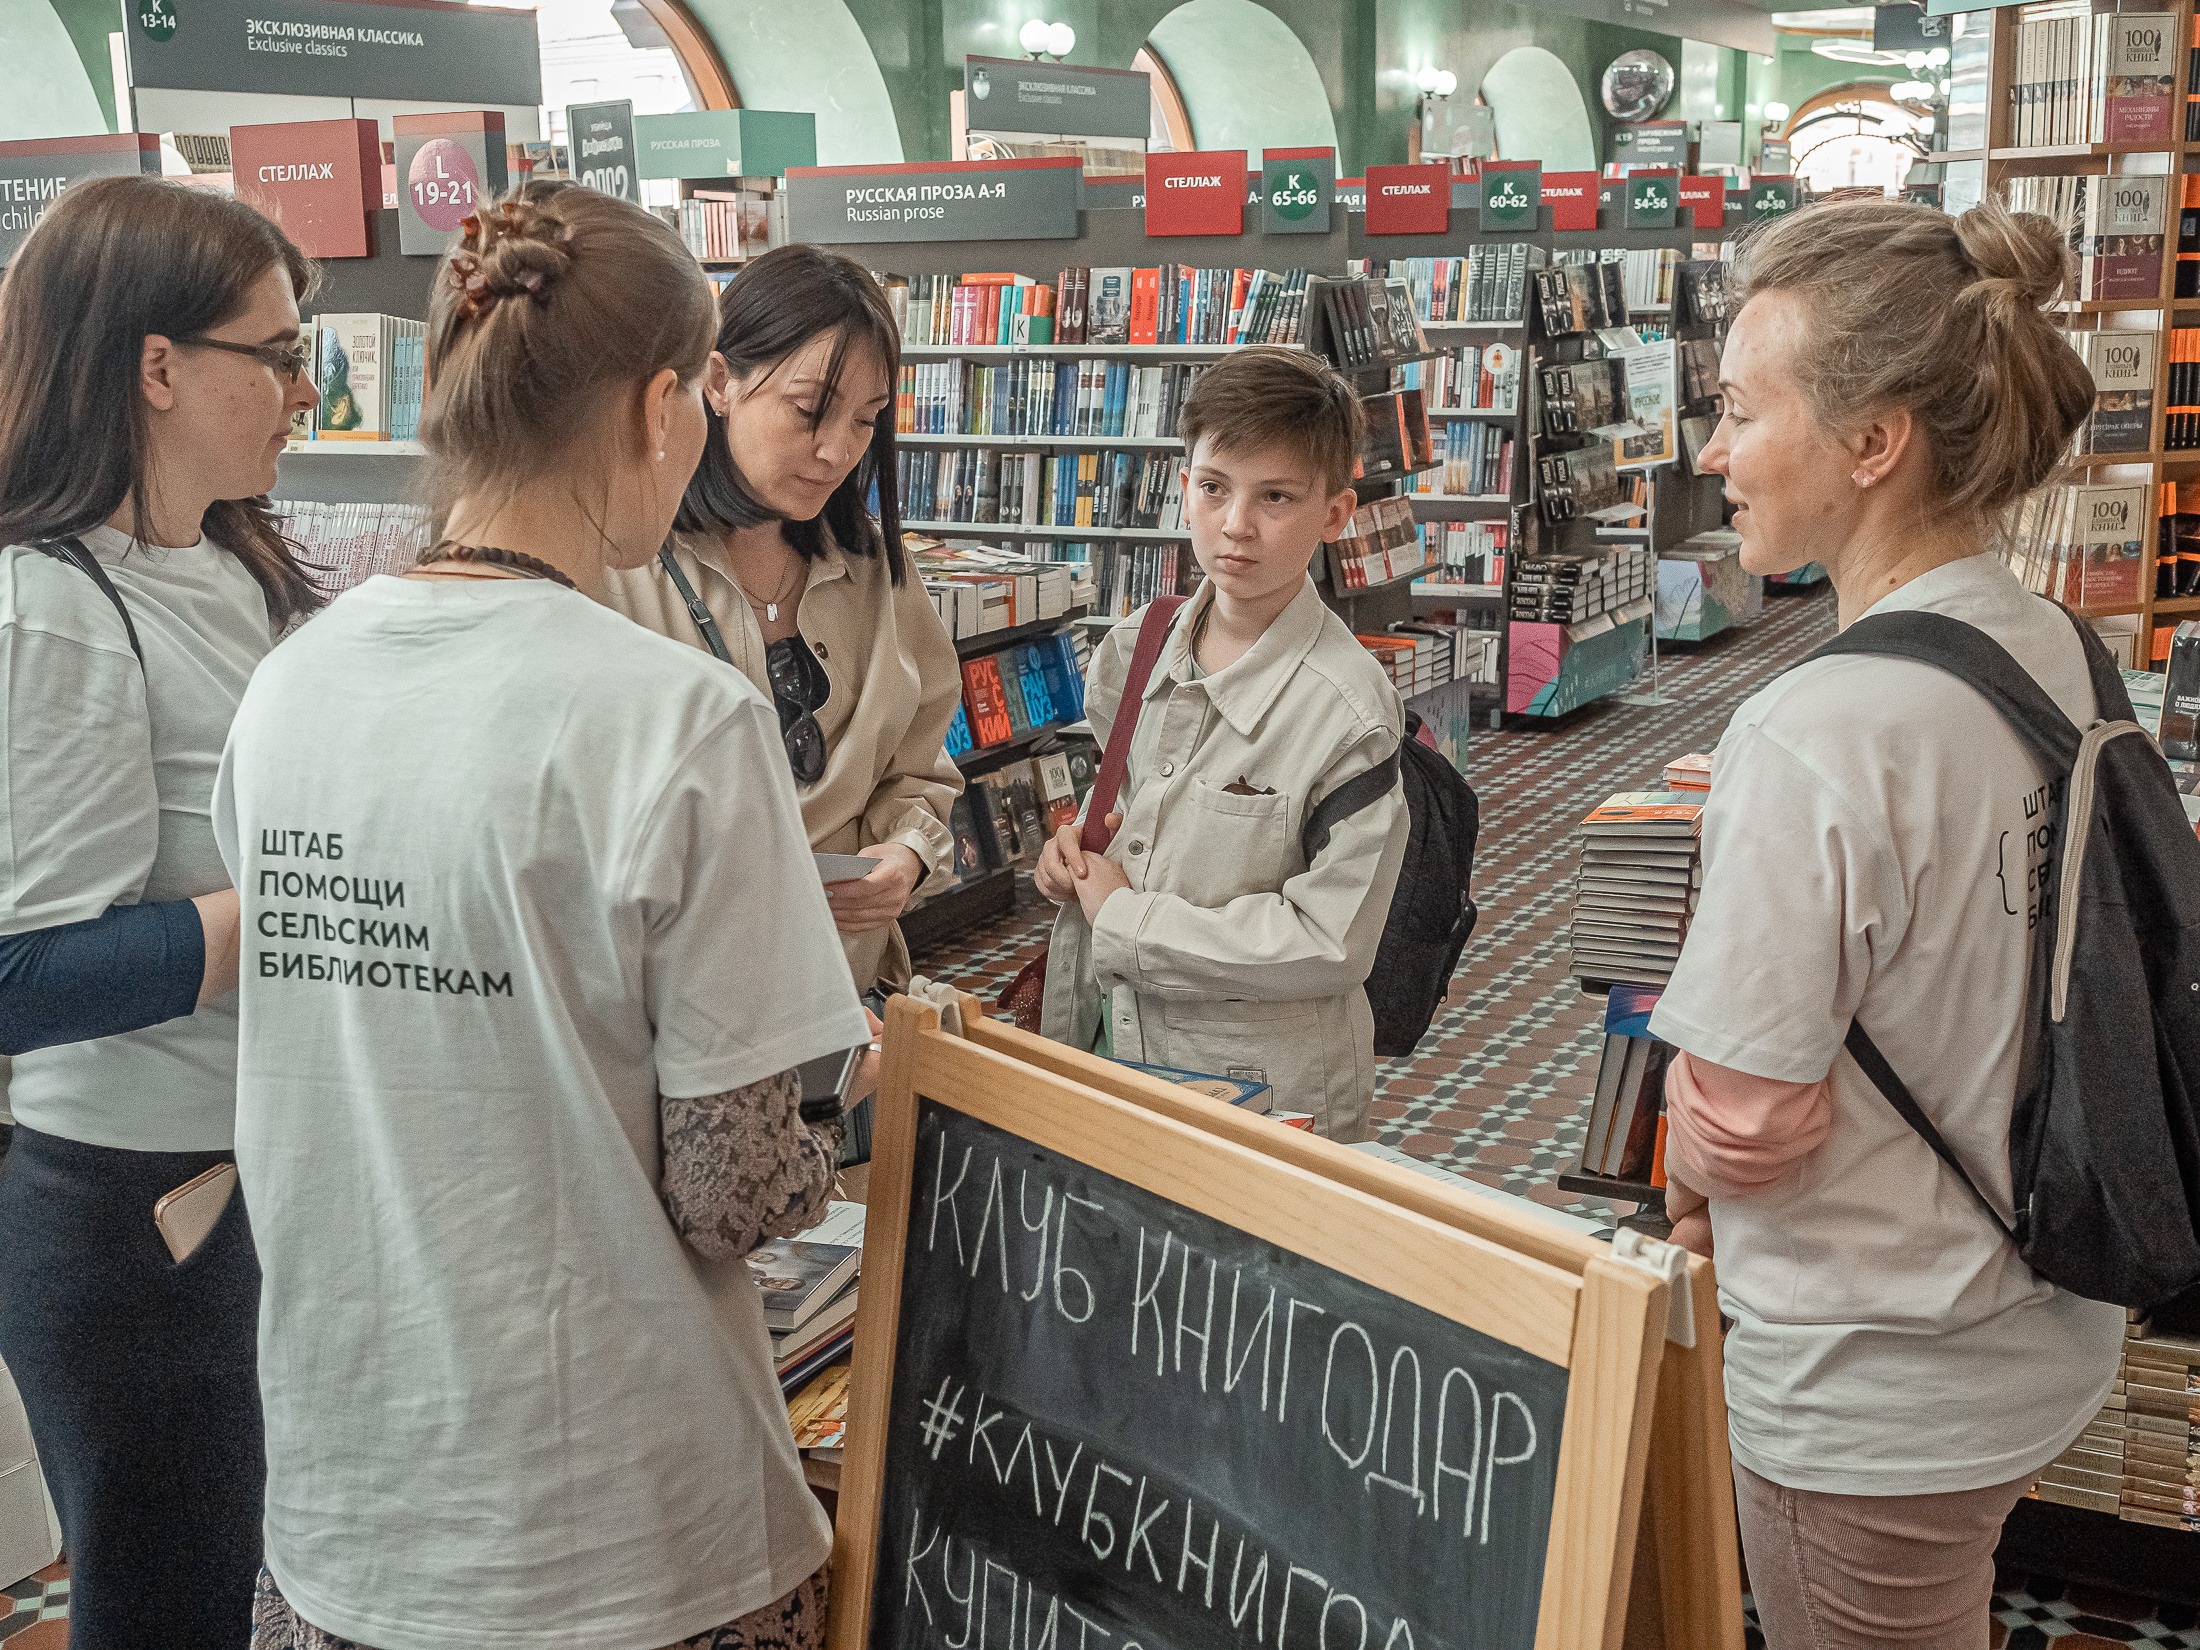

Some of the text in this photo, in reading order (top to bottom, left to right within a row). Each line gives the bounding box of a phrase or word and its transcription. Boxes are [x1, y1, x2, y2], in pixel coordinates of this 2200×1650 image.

[141, 14, 176, 29] 13-14
[245, 19, 424, 46] ЭКСКЛЮЗИВНАЯ КЛАССИКА
[2125, 29, 2154, 47] 100
[247, 36, 348, 57] Exclusive classics
[651, 138, 720, 150] РУССКАЯ ПРОЗА
[258, 162, 334, 183] СТЕЛЛАЖ
[437, 156, 449, 179] L
[0, 177, 66, 201] ТЕНИЕ
[1164, 176, 1222, 189] СТЕЛЛАЖ
[1381, 184, 1431, 196] СТЕЛЛАЖ
[414, 180, 472, 206] 19-21
[846, 183, 1006, 204] РУССКАЯ ПРОЗА А-Я
[1272, 189, 1317, 206] 65-66
[1489, 195, 1528, 208] 60-62
[2114, 190, 2143, 208] 100
[1634, 198, 1668, 209] 54-56
[1755, 199, 1786, 210] 49-50
[847, 206, 944, 222] Russian prose
[2104, 347, 2133, 364] 100
[2091, 501, 2121, 518] 100
[261, 829, 343, 860] ШТАБ
[259, 870, 404, 910] ПОМОЩИ
[258, 911, 430, 951] СЕЛЬСКИМ
[260, 952, 513, 997] БИБЛИОТЕКАМ
[929, 1131, 1537, 1544] КЛУБ КНИГОДАР
[905, 1508, 1144, 1650] КУПИТ
